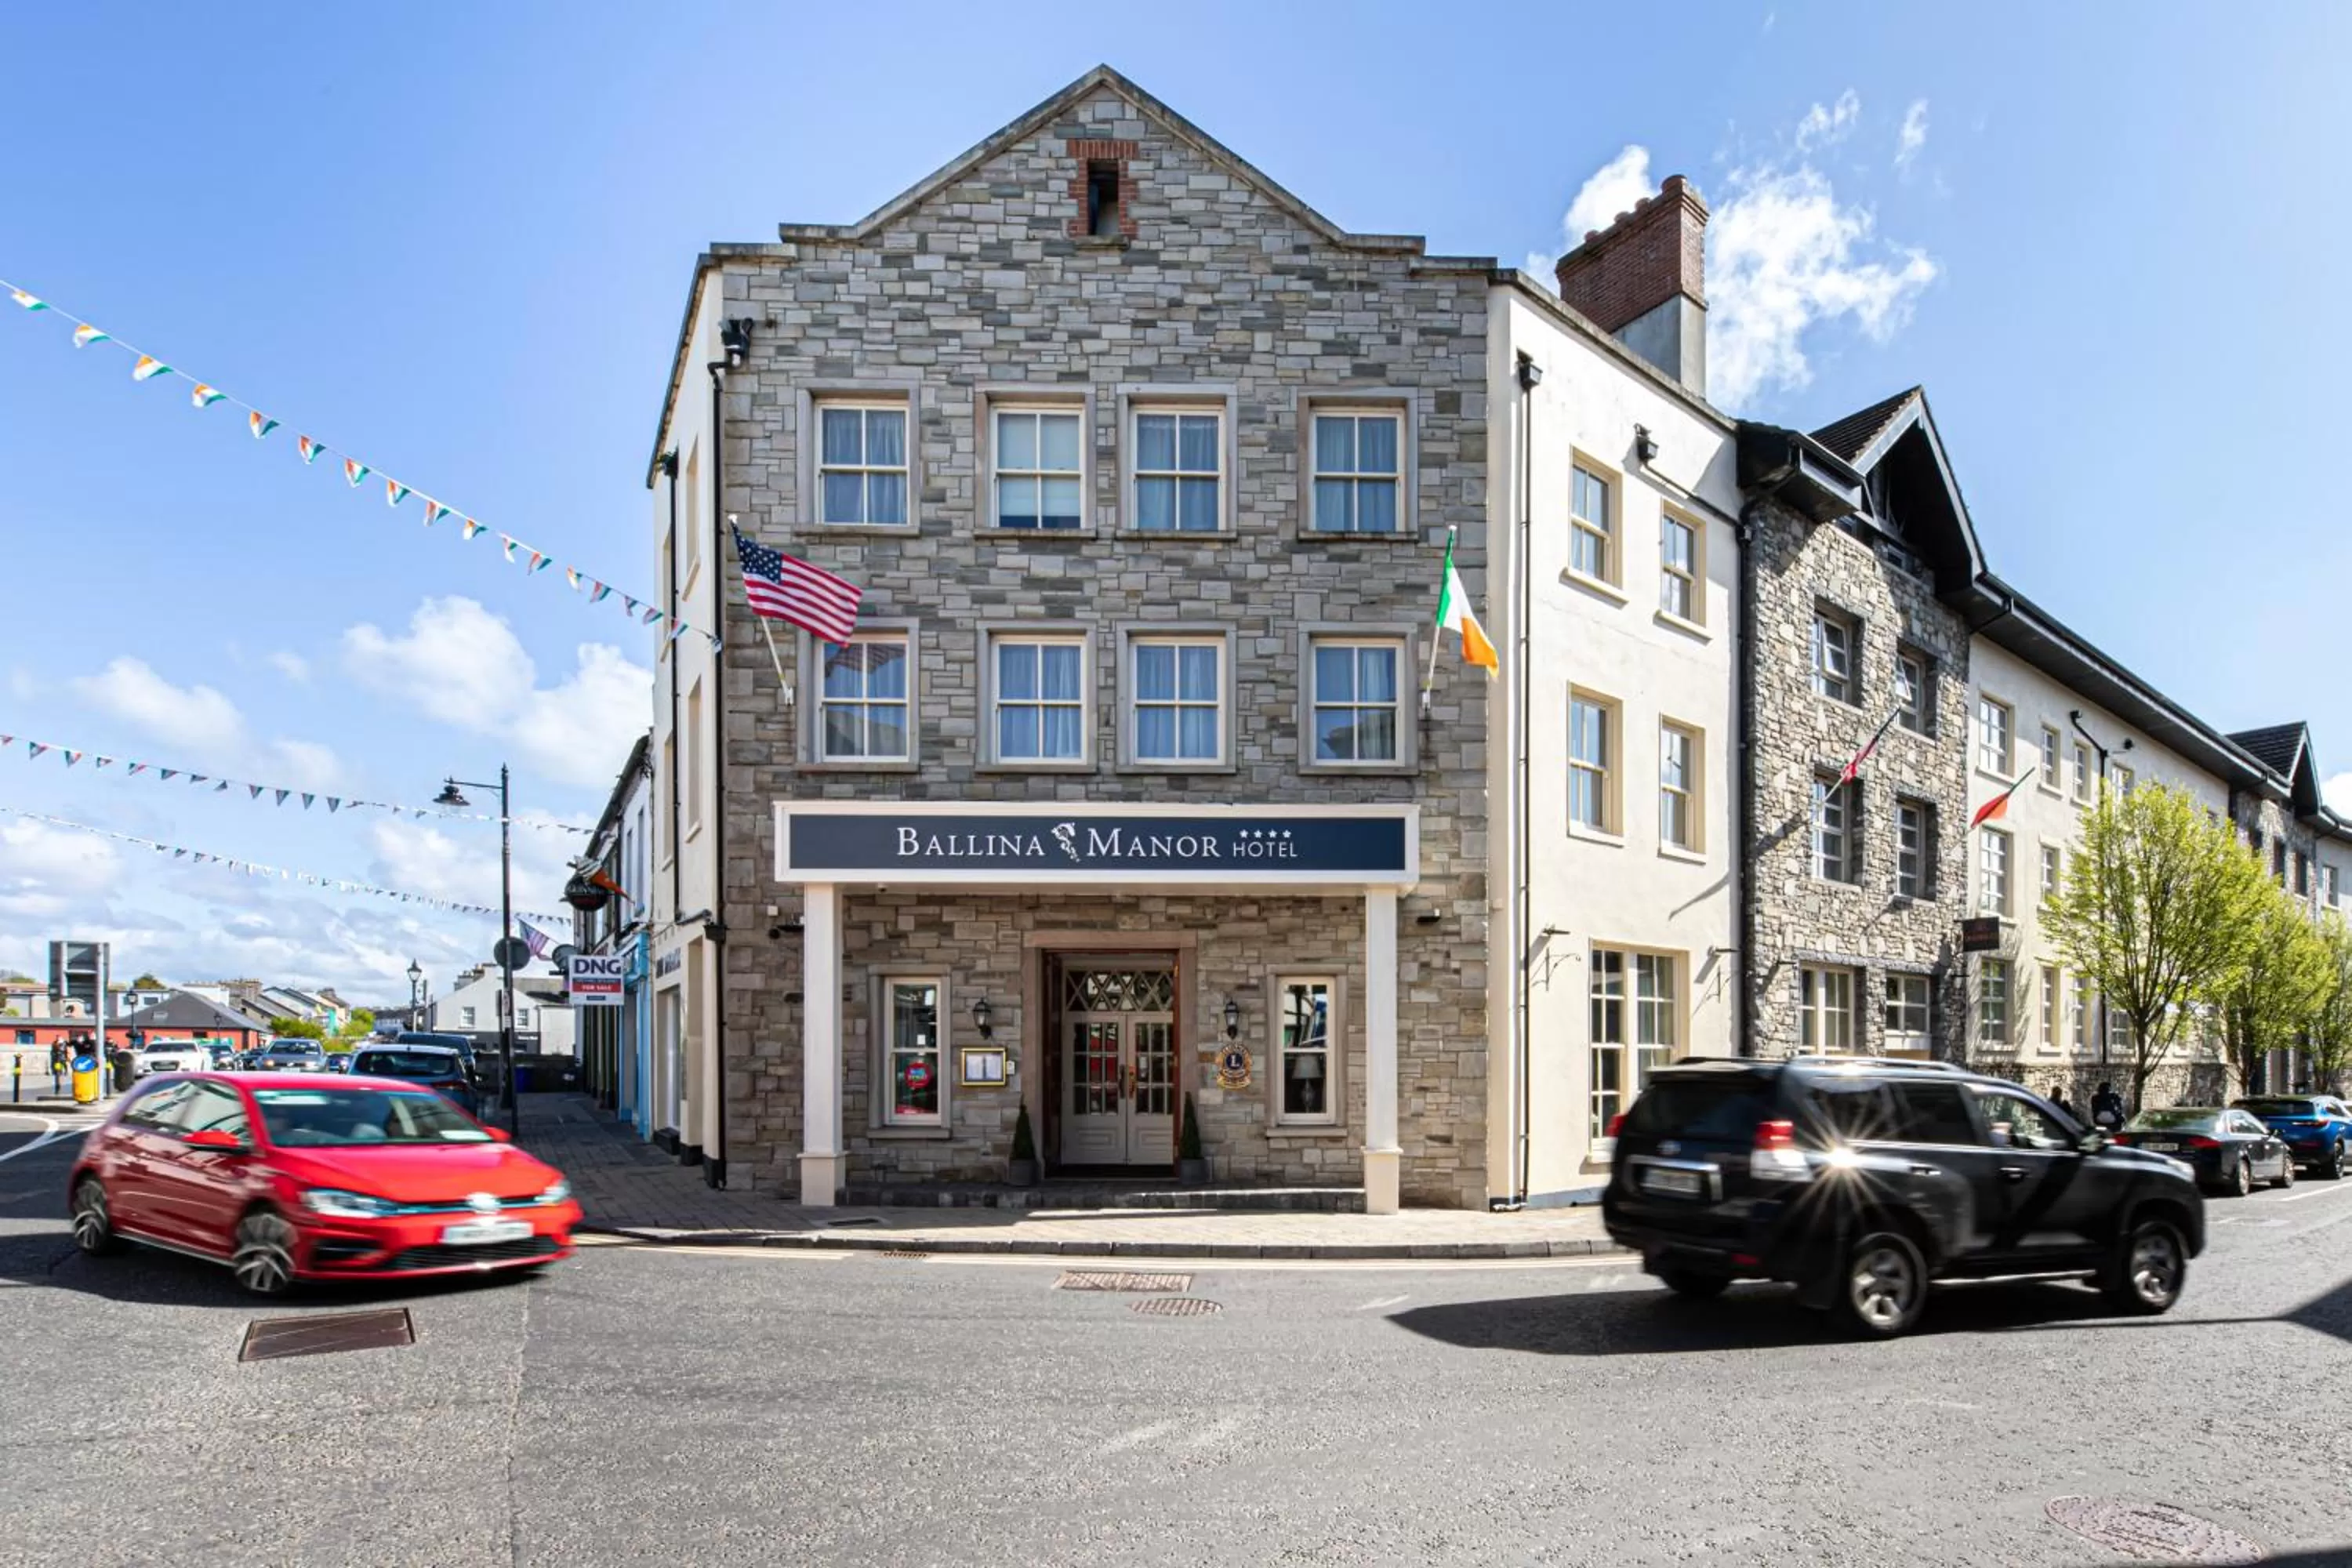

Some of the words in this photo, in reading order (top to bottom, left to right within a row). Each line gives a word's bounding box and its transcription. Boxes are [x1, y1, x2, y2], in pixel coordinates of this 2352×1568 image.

[896, 827, 1047, 856] BALLINA
[1087, 827, 1221, 857] MANOR
[1232, 841, 1298, 858] HOTEL
[575, 959, 622, 975] DNG
[1231, 1054, 1240, 1067] L
